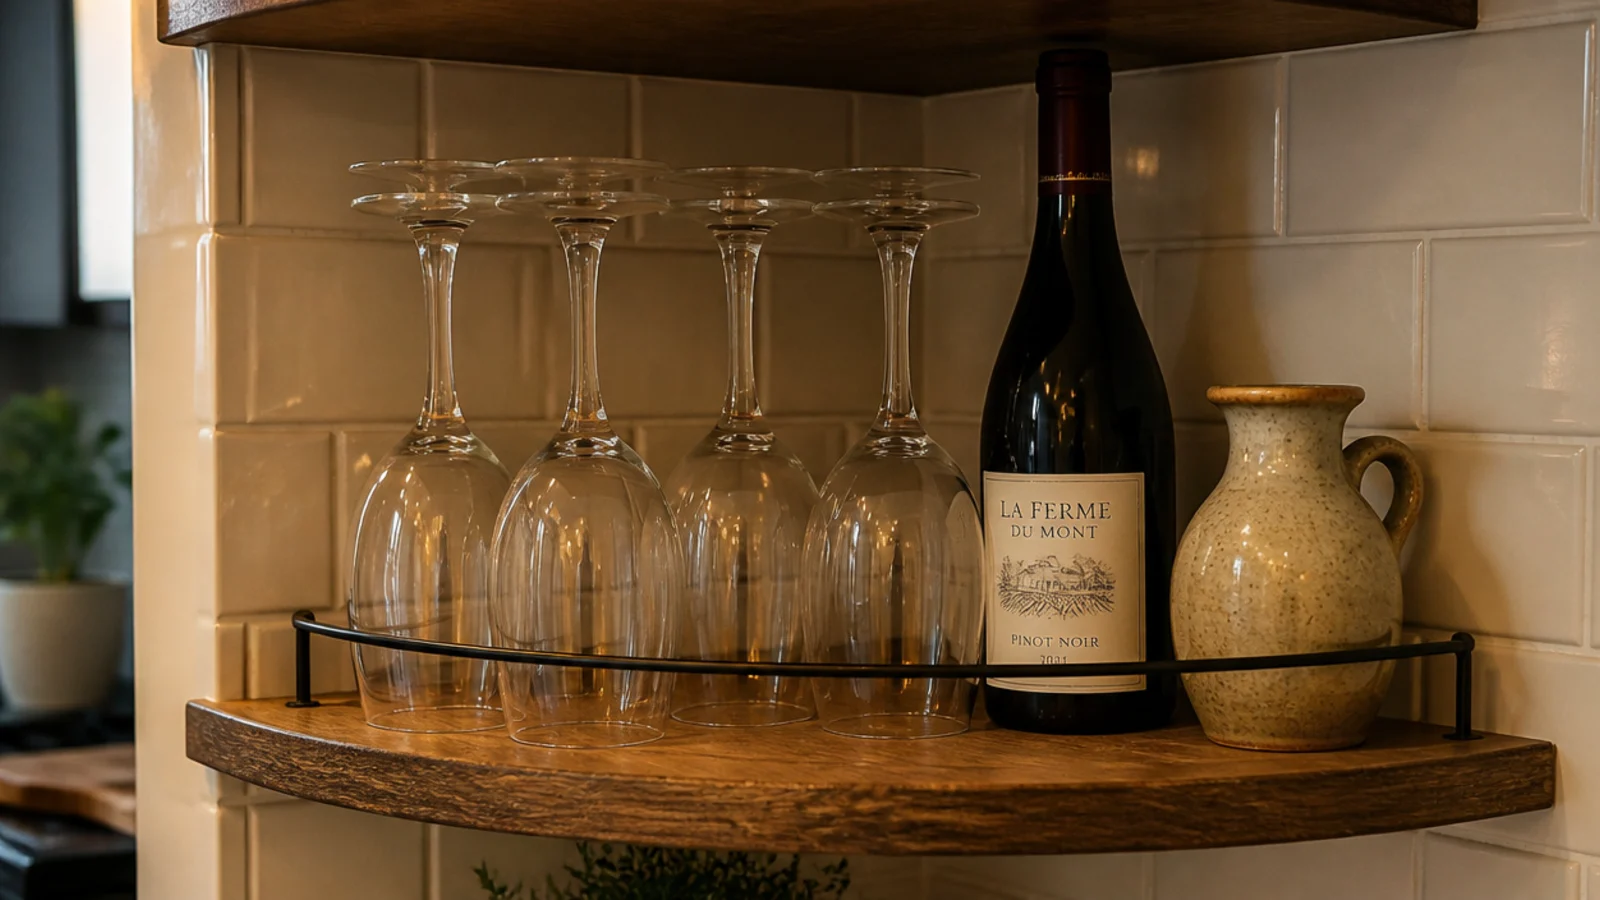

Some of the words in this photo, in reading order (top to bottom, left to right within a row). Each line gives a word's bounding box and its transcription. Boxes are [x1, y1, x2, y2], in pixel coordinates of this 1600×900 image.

[1001, 500, 1023, 519] LA
[1031, 501, 1112, 520] FERME
[1011, 524, 1033, 538] DU
[1041, 525, 1098, 539] MONT
[1011, 634, 1053, 647] PINOT
[1059, 637, 1099, 648] NOIR
